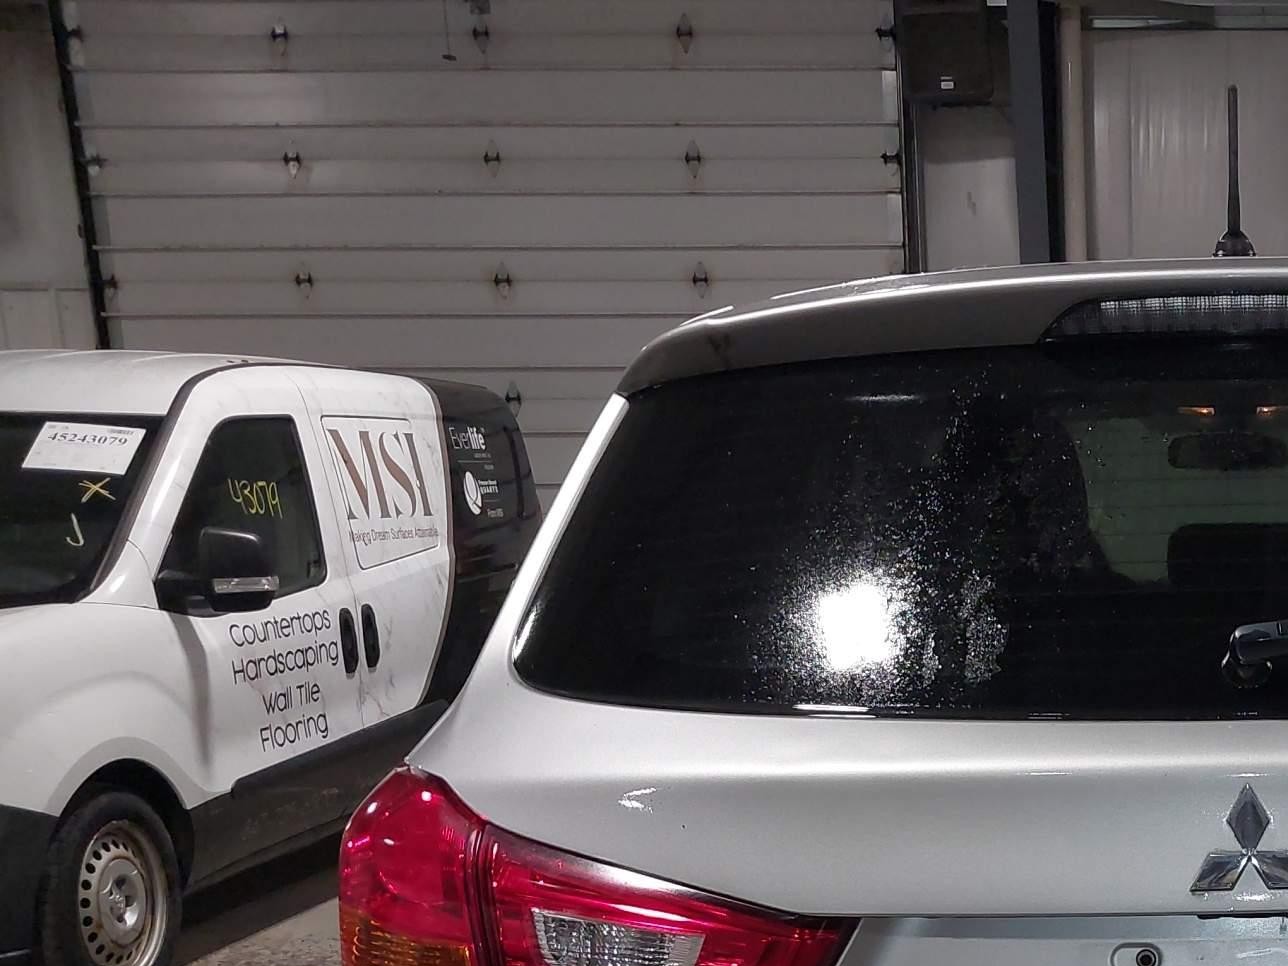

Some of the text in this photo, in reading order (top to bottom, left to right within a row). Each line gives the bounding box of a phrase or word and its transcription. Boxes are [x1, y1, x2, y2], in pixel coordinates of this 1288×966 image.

[47, 431, 128, 447] 45243079
[326, 428, 434, 520] MSI
[226, 478, 284, 520] 43079
[229, 609, 332, 648] Countertops
[231, 639, 339, 685] Hardscaping
[262, 681, 321, 716] Wall Tile
[260, 711, 329, 752] Flooring
